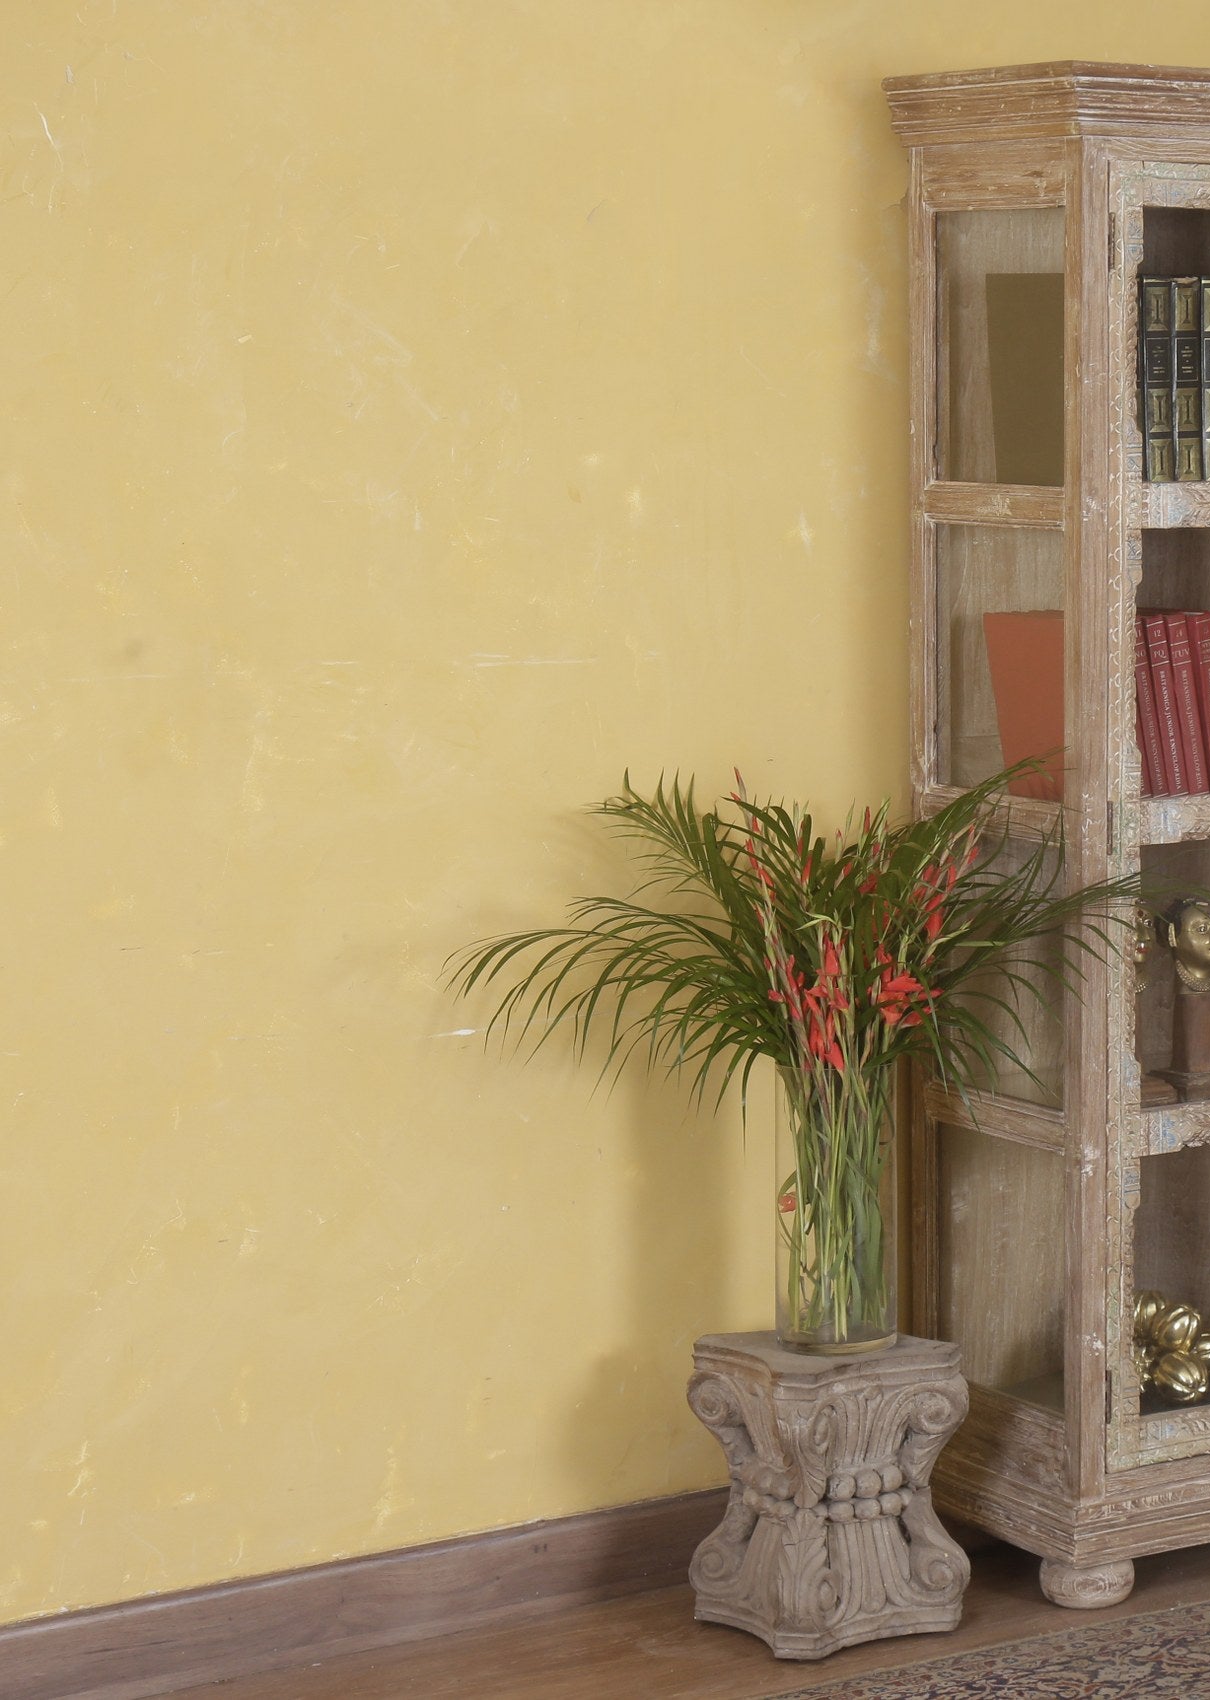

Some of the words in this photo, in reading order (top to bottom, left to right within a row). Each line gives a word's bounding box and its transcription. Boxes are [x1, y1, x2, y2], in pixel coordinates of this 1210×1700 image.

[1153, 629, 1161, 637] 12
[1153, 650, 1167, 659] PQ
[1172, 648, 1190, 659] TUV
[1181, 669, 1191, 710] BRITANNICA
[1159, 671, 1169, 711] BRITANNICA
[1164, 711, 1174, 737] JUNIOR
